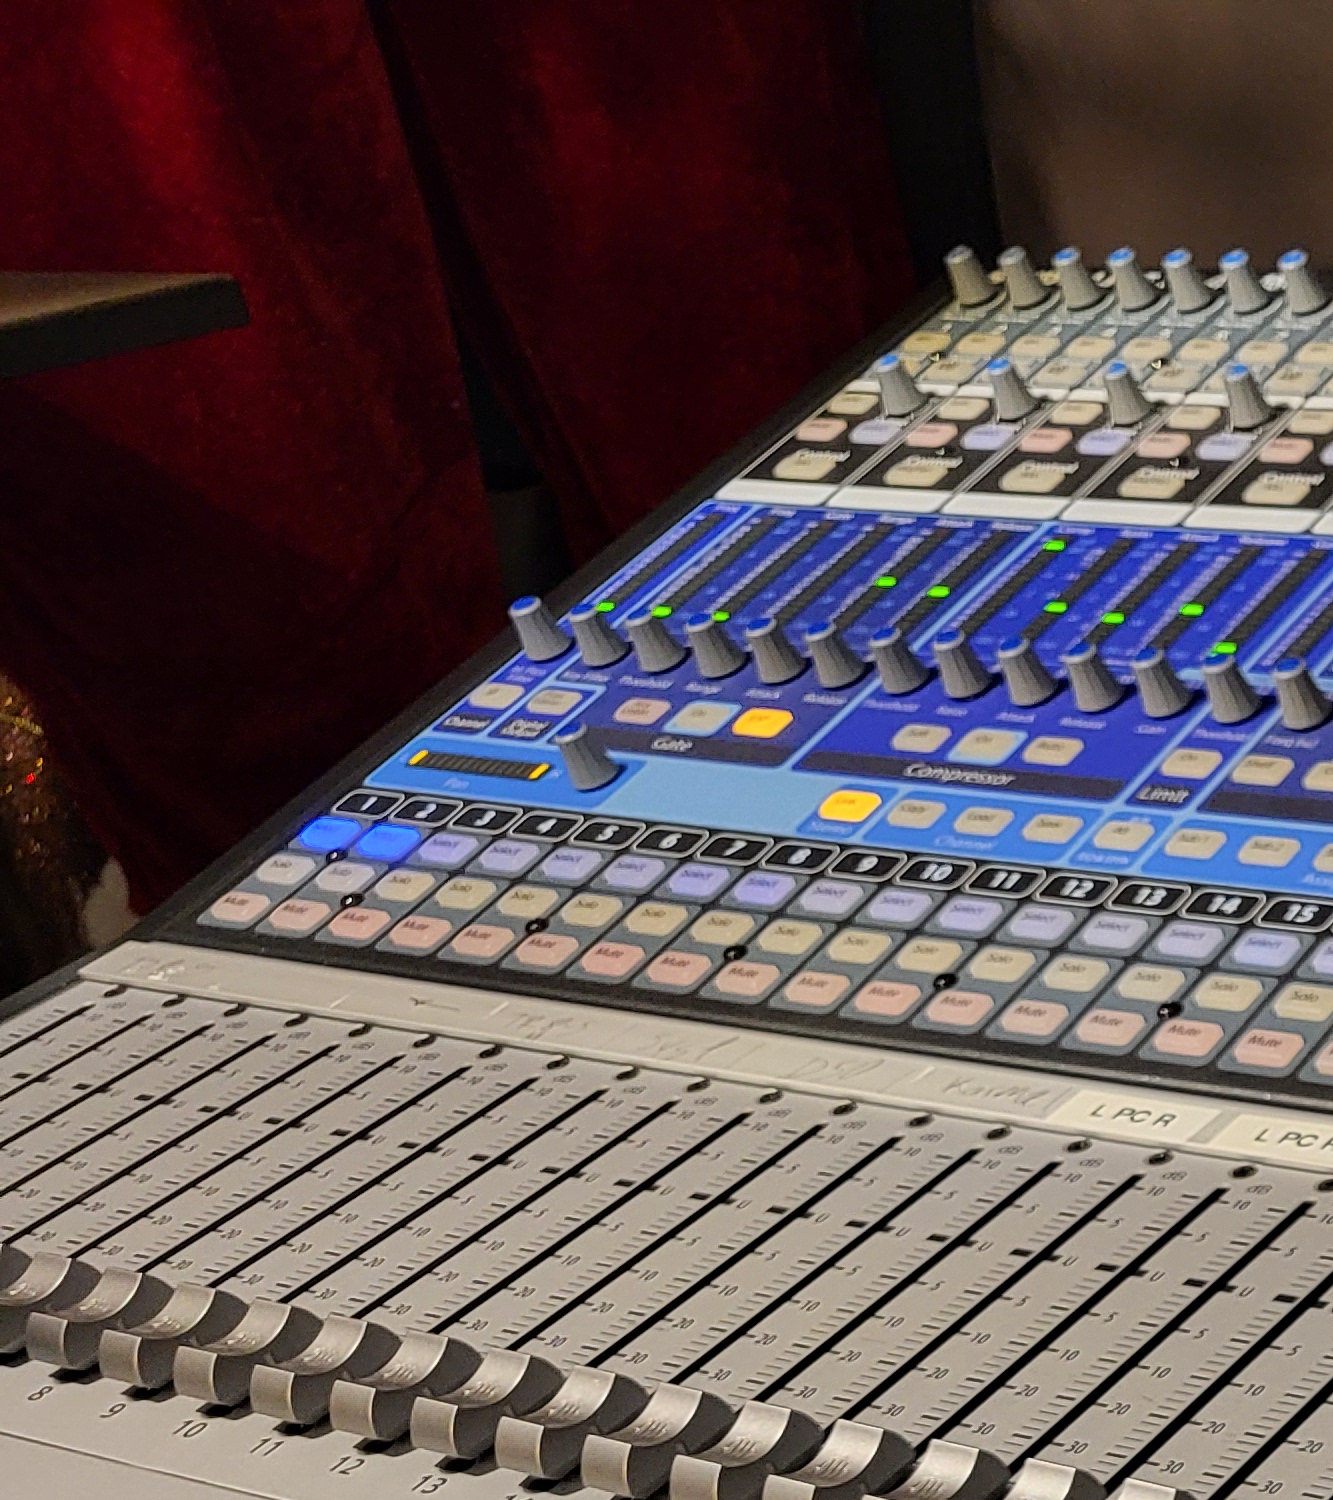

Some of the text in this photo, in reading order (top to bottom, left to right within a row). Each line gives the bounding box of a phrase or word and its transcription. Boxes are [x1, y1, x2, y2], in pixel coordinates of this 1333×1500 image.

[903, 763, 1016, 787] Compressor
[1138, 786, 1189, 803] Limit
[657, 833, 679, 851] 6
[790, 848, 811, 866] 8
[859, 854, 879, 872] 9
[919, 863, 954, 882] 10
[991, 871, 1024, 890] 11
[1061, 878, 1094, 898] 12
[1133, 887, 1166, 906] 13
[1206, 896, 1241, 915] 14
[1281, 904, 1317, 924] 15
[1089, 1103, 1177, 1128] L PC R
[1253, 1127, 1269, 1143] L
[1276, 1131, 1320, 1148] PC
[27, 1385, 54, 1402] 8
[99, 1402, 127, 1419] 9
[172, 1419, 209, 1439] 10
[249, 1437, 285, 1457] 11
[329, 1455, 366, 1476] 12
[411, 1474, 448, 1495] 13
